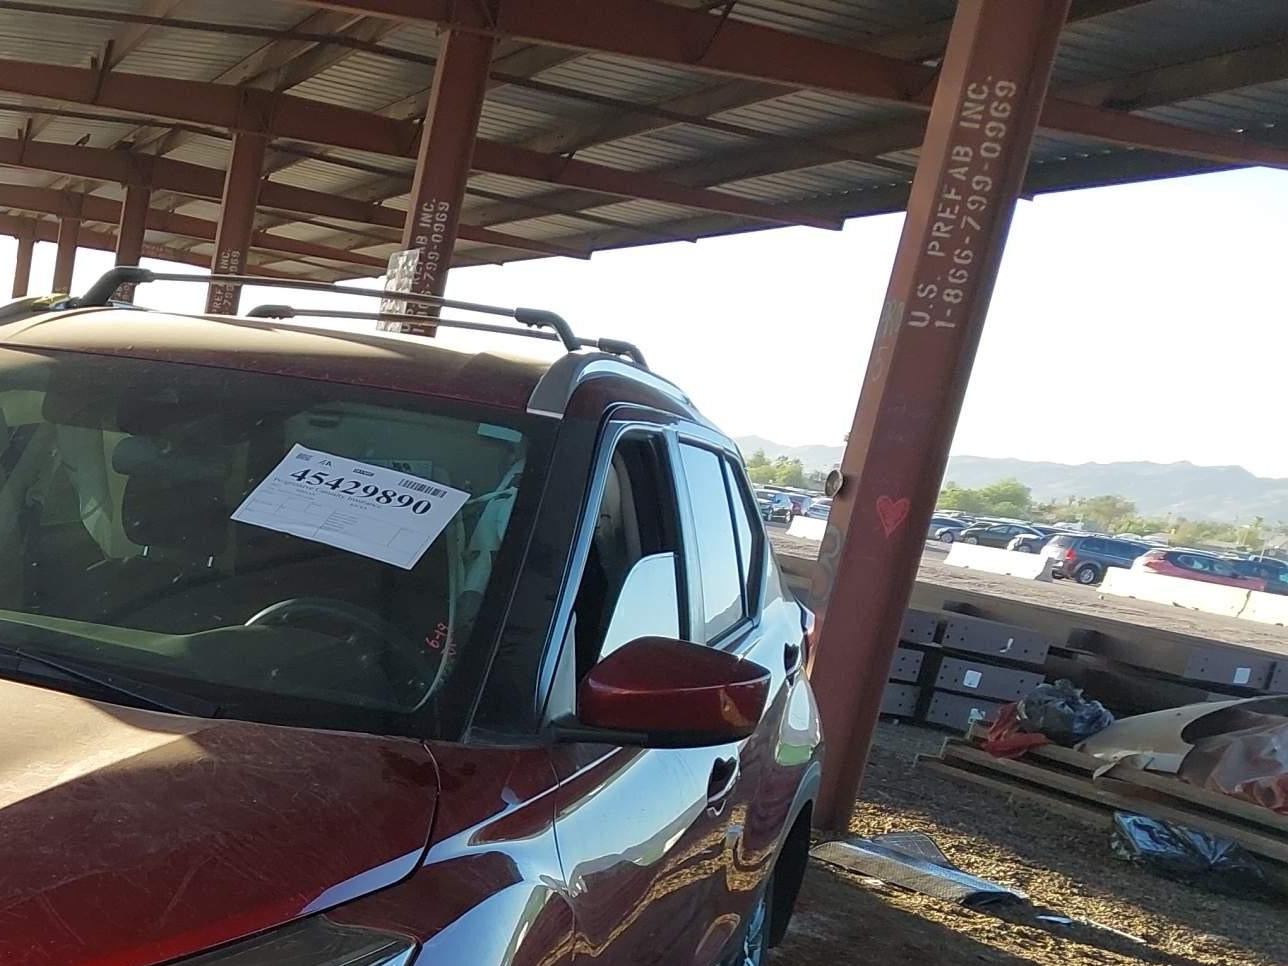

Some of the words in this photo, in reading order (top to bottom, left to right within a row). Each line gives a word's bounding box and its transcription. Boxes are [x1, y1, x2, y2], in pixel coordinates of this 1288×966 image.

[419, 198, 437, 227] INC.
[908, 276, 942, 328] U.S.
[927, 145, 974, 257] PREFAB
[960, 75, 993, 129] INC.
[935, 80, 1017, 329] 1-866-799-0969
[289, 467, 432, 516] 45429890
